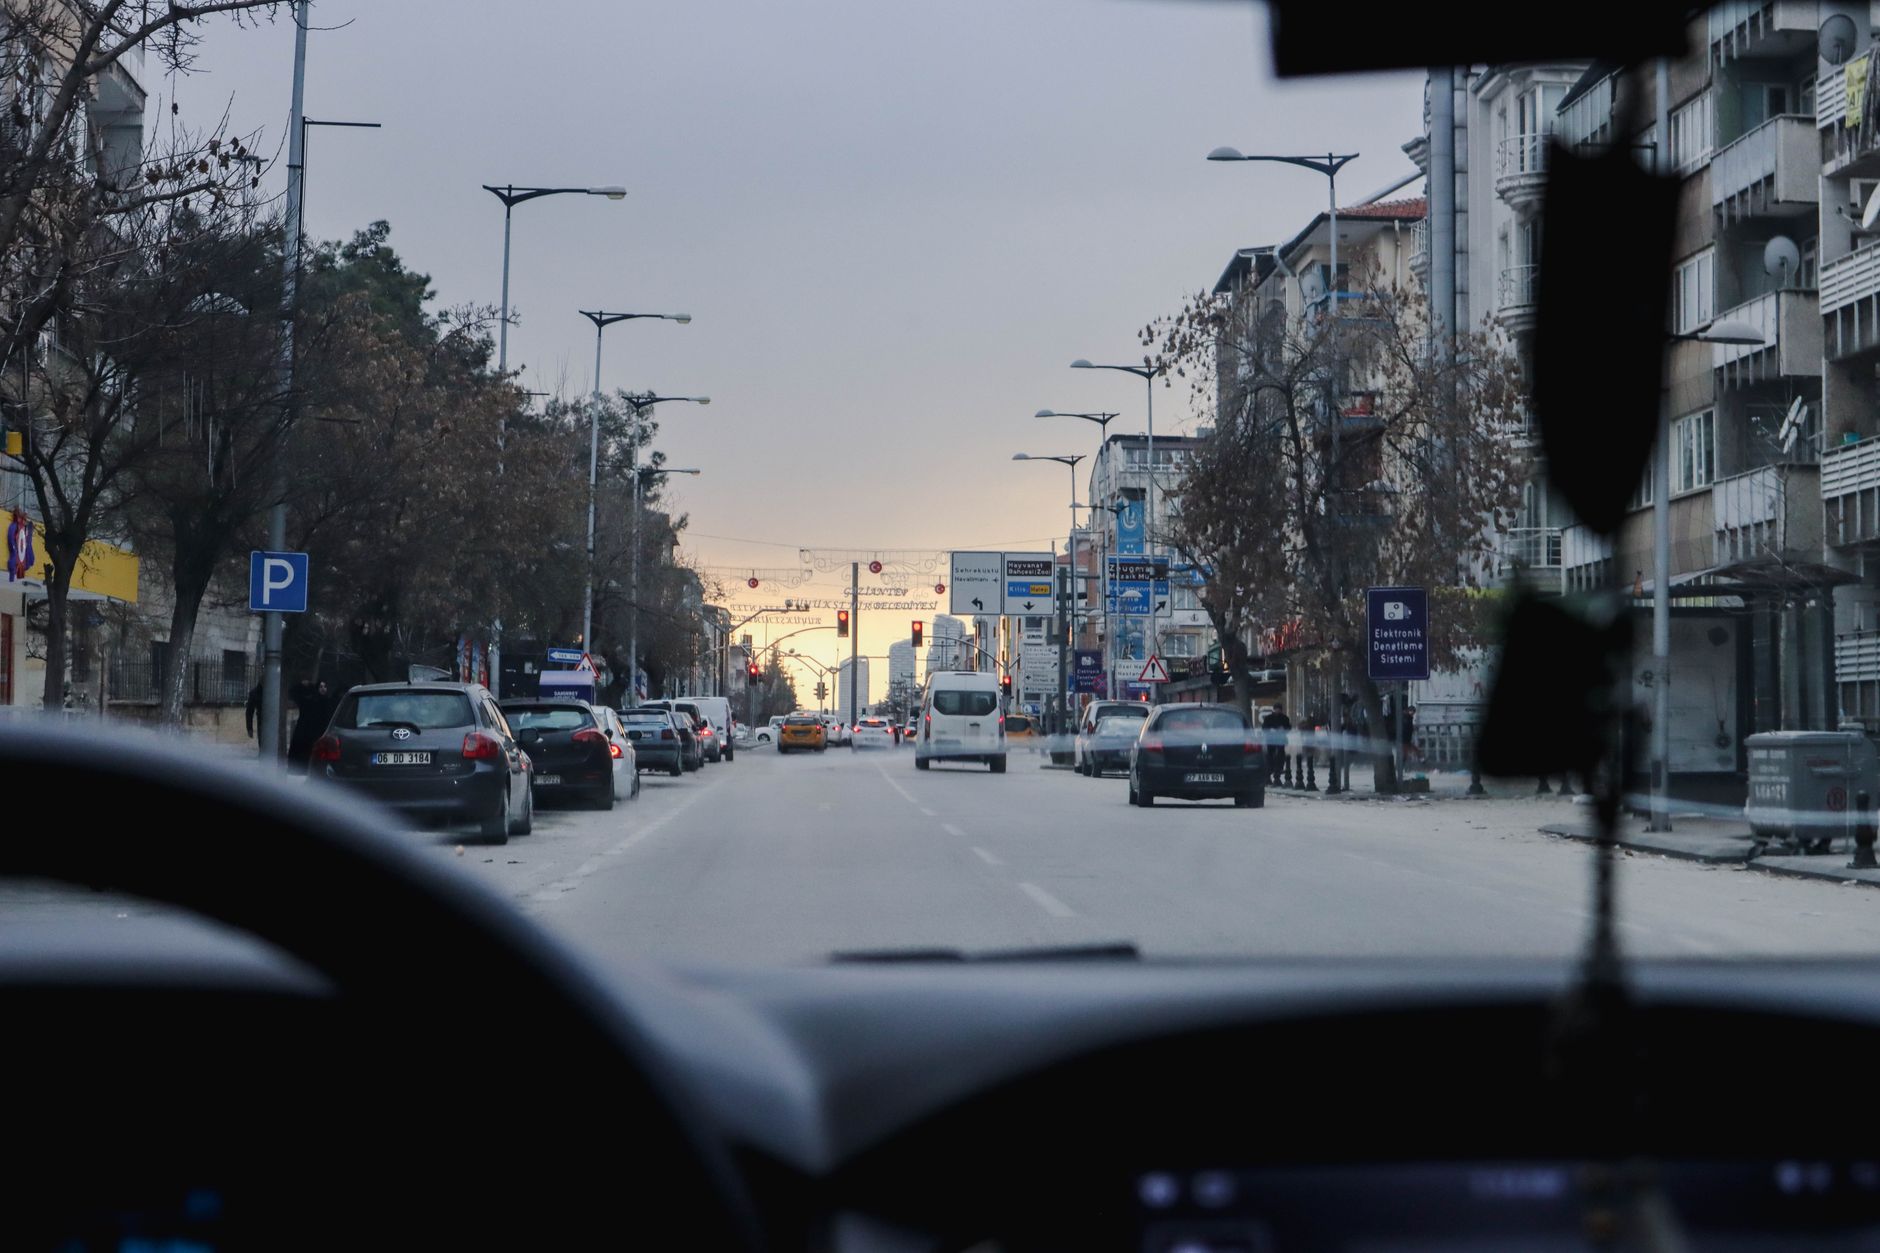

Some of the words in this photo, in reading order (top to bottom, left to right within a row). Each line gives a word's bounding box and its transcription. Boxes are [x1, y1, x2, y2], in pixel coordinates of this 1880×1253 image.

[1008, 562, 1043, 570] Hayvanat
[263, 558, 294, 605] P
[843, 586, 908, 599] GZİANTEP
[1375, 629, 1422, 638] Elektronik
[1374, 641, 1423, 651] Denetleme
[1381, 654, 1416, 664] Sistemi
[377, 753, 388, 763] 06
[408, 753, 429, 763] 3184
